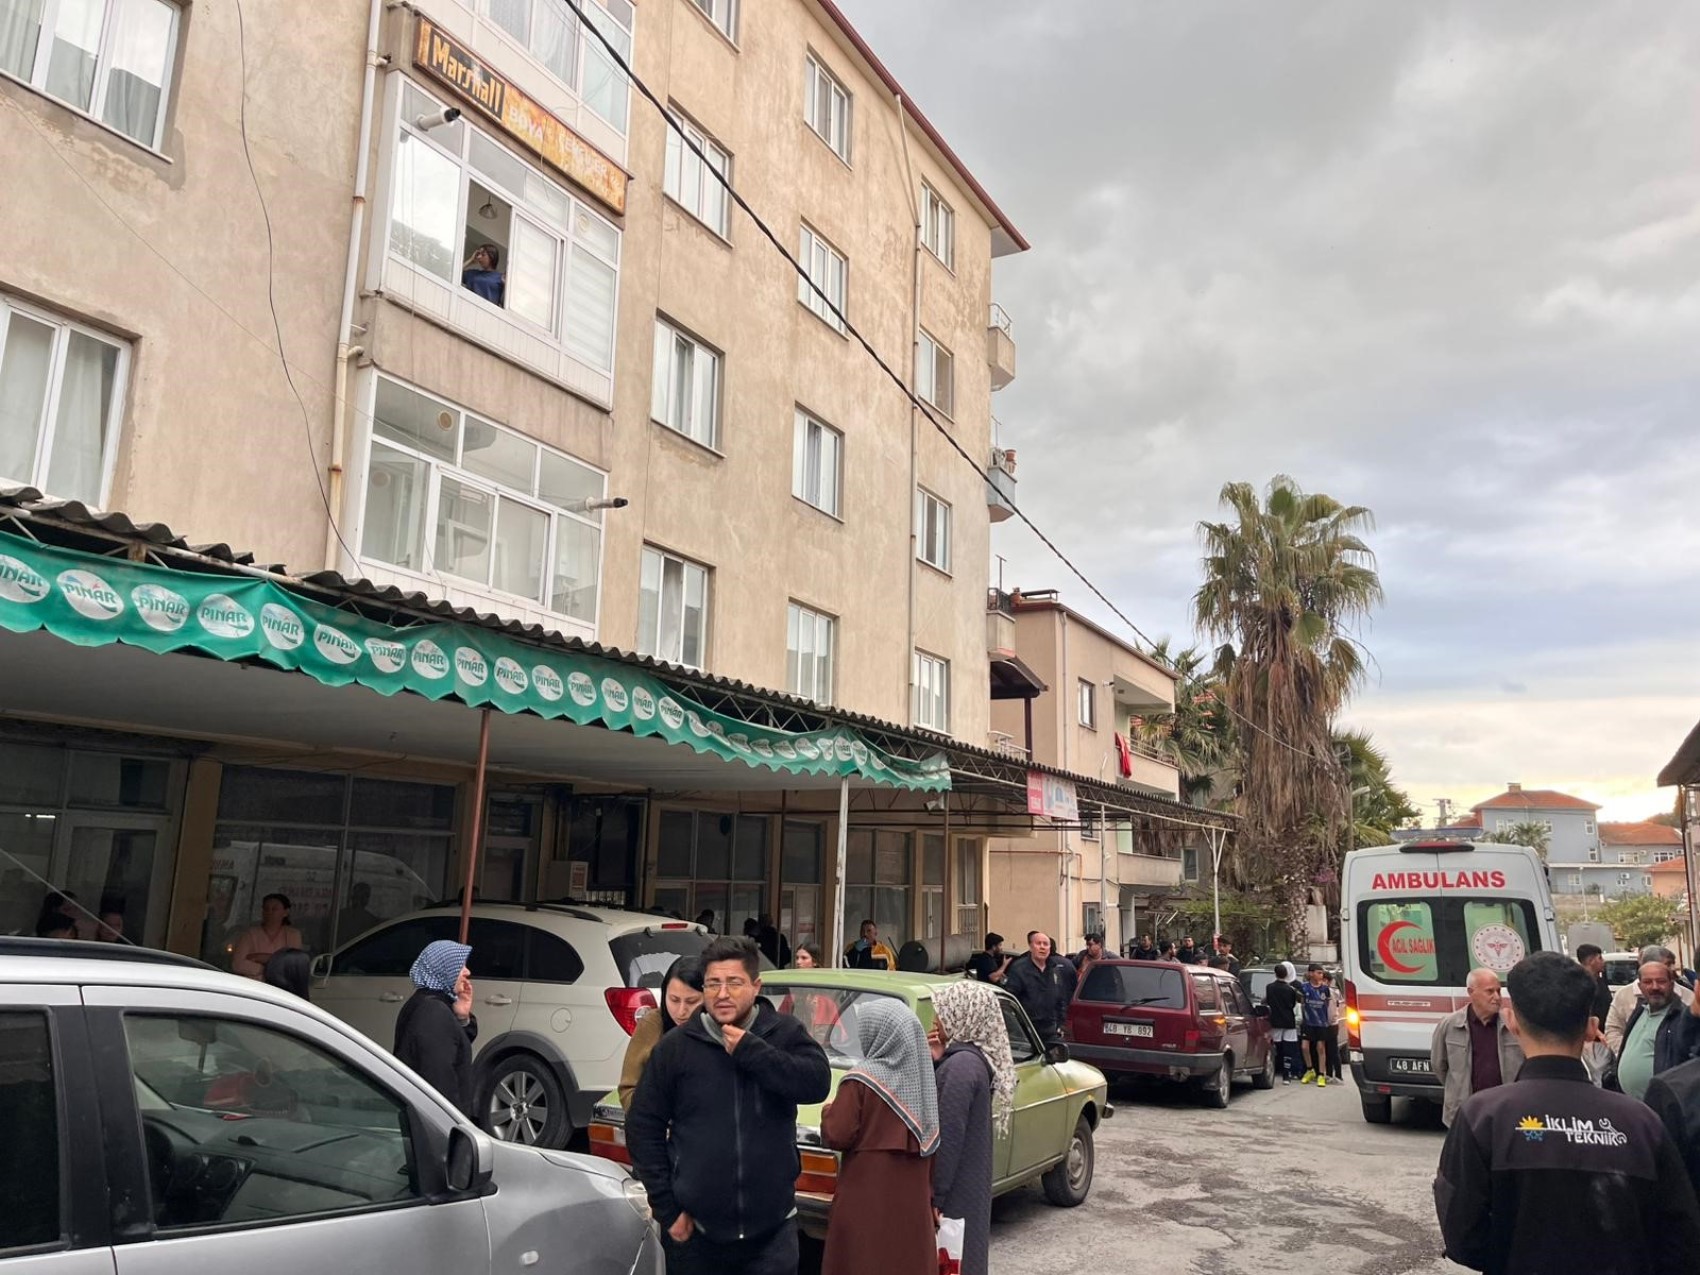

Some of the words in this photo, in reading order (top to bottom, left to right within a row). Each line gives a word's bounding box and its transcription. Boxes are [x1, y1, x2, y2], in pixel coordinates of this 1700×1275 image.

[432, 34, 502, 113] Marshall
[0, 564, 43, 587] INAR
[64, 584, 117, 604] PINAR
[138, 596, 187, 615] PINAR
[200, 606, 248, 623] PINAR
[262, 614, 300, 636] PINAR
[372, 645, 405, 660] PINAR
[413, 651, 445, 666] PINAR
[456, 657, 485, 674] PINAR
[496, 667, 526, 682] PINAR
[535, 674, 561, 689] PINAR
[1372, 870, 1506, 891] AMBULANS
[1396, 1060, 1408, 1071] 48
[1412, 1060, 1430, 1072] AFN
